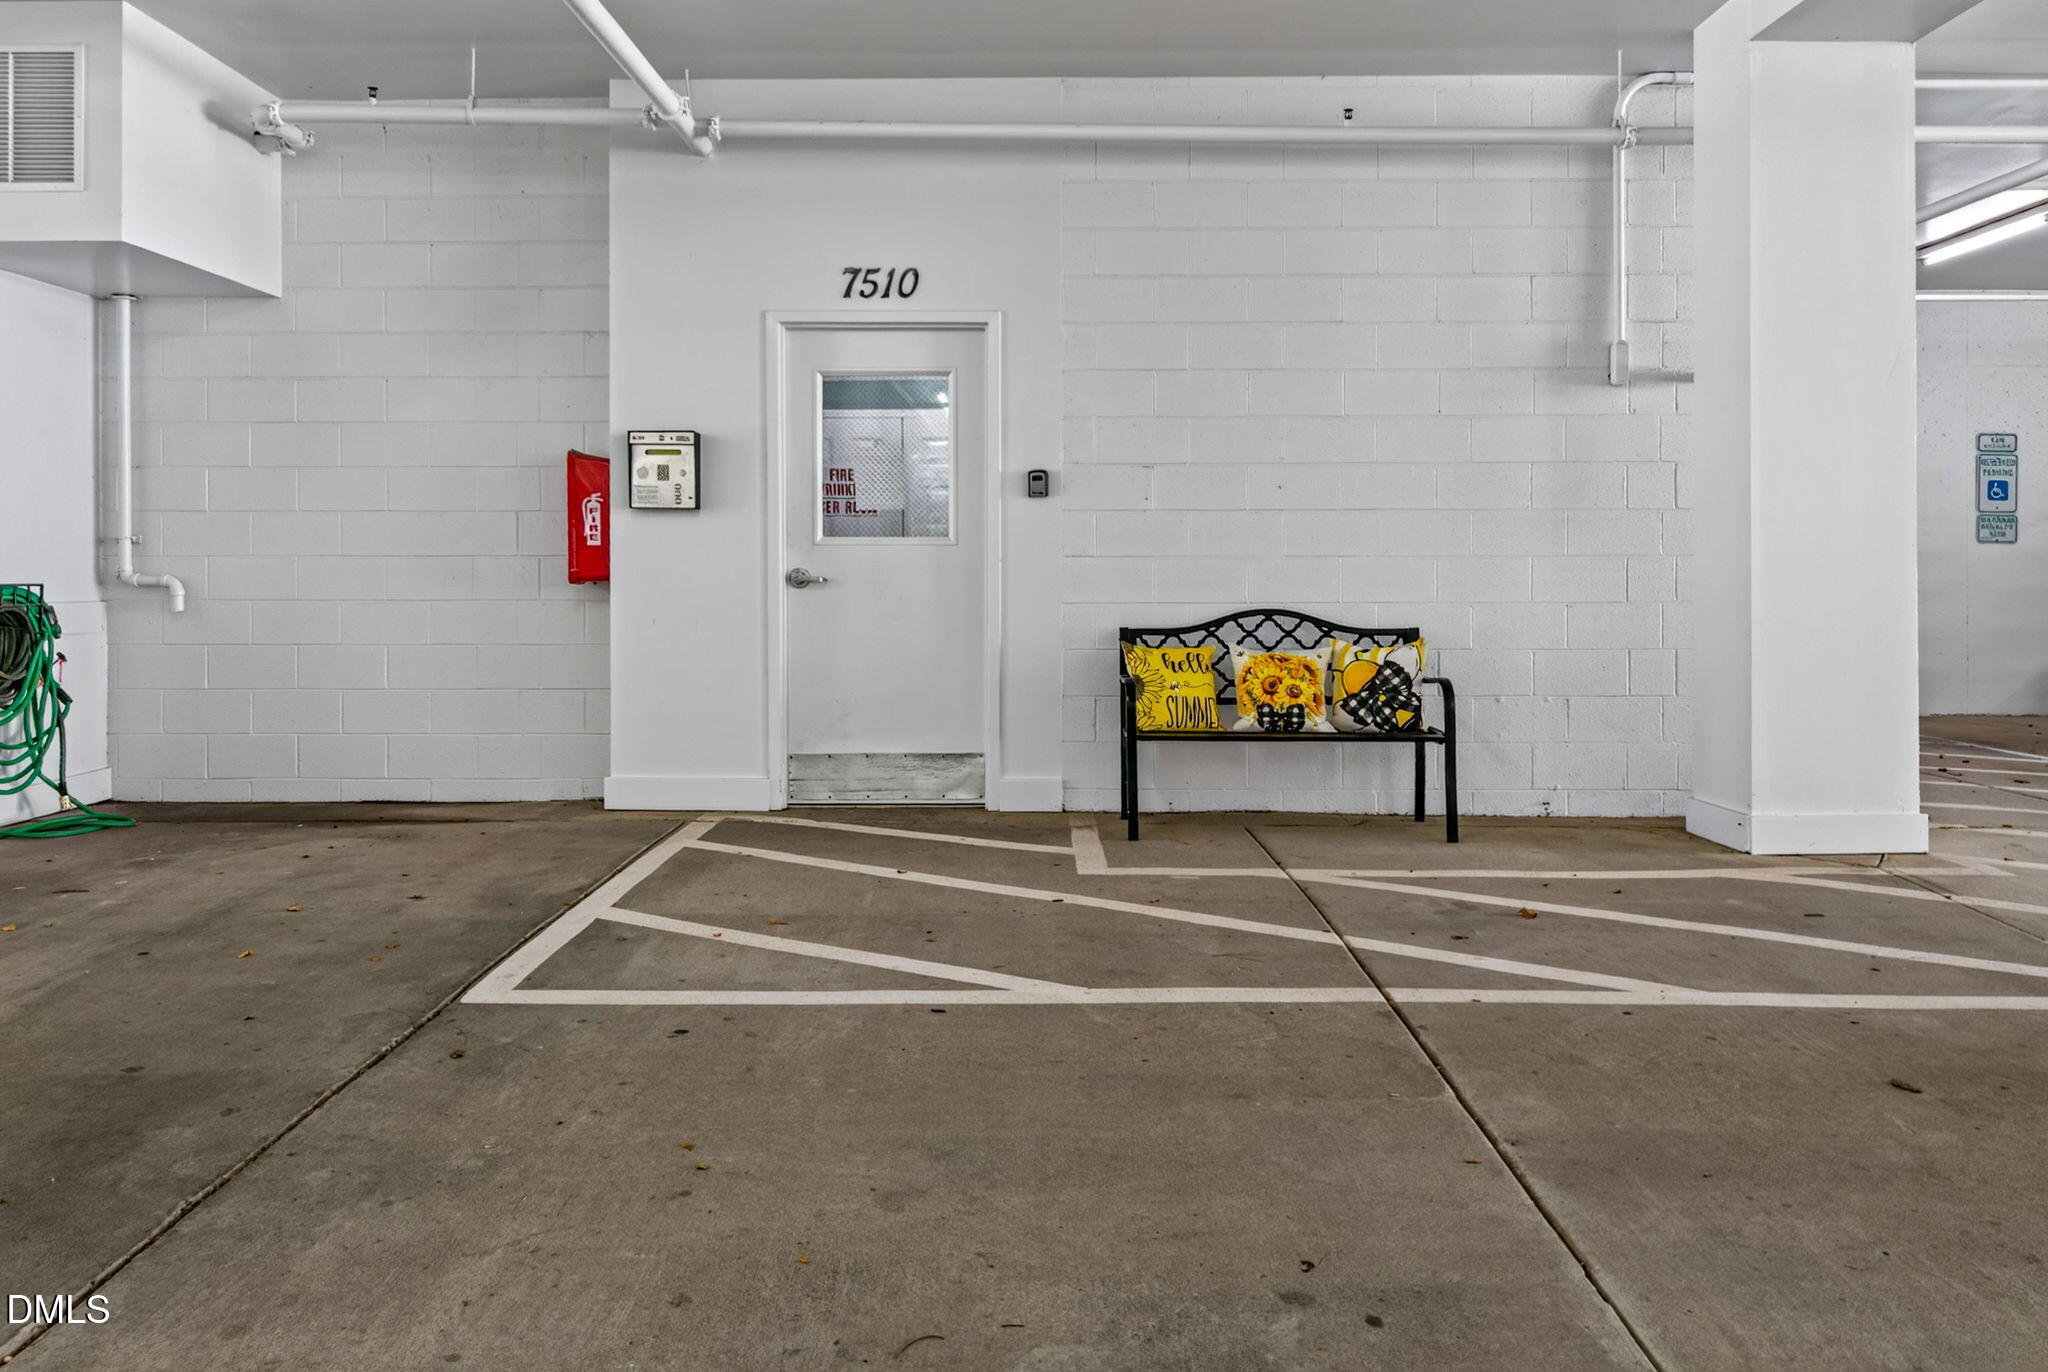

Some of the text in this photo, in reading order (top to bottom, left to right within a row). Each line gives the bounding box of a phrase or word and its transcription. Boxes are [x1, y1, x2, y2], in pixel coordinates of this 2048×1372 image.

[843, 267, 919, 298] 7510
[823, 483, 856, 496] RINK
[829, 468, 854, 481] FIRE
[589, 507, 599, 541] FIRE
[1166, 695, 1219, 729] SUMME
